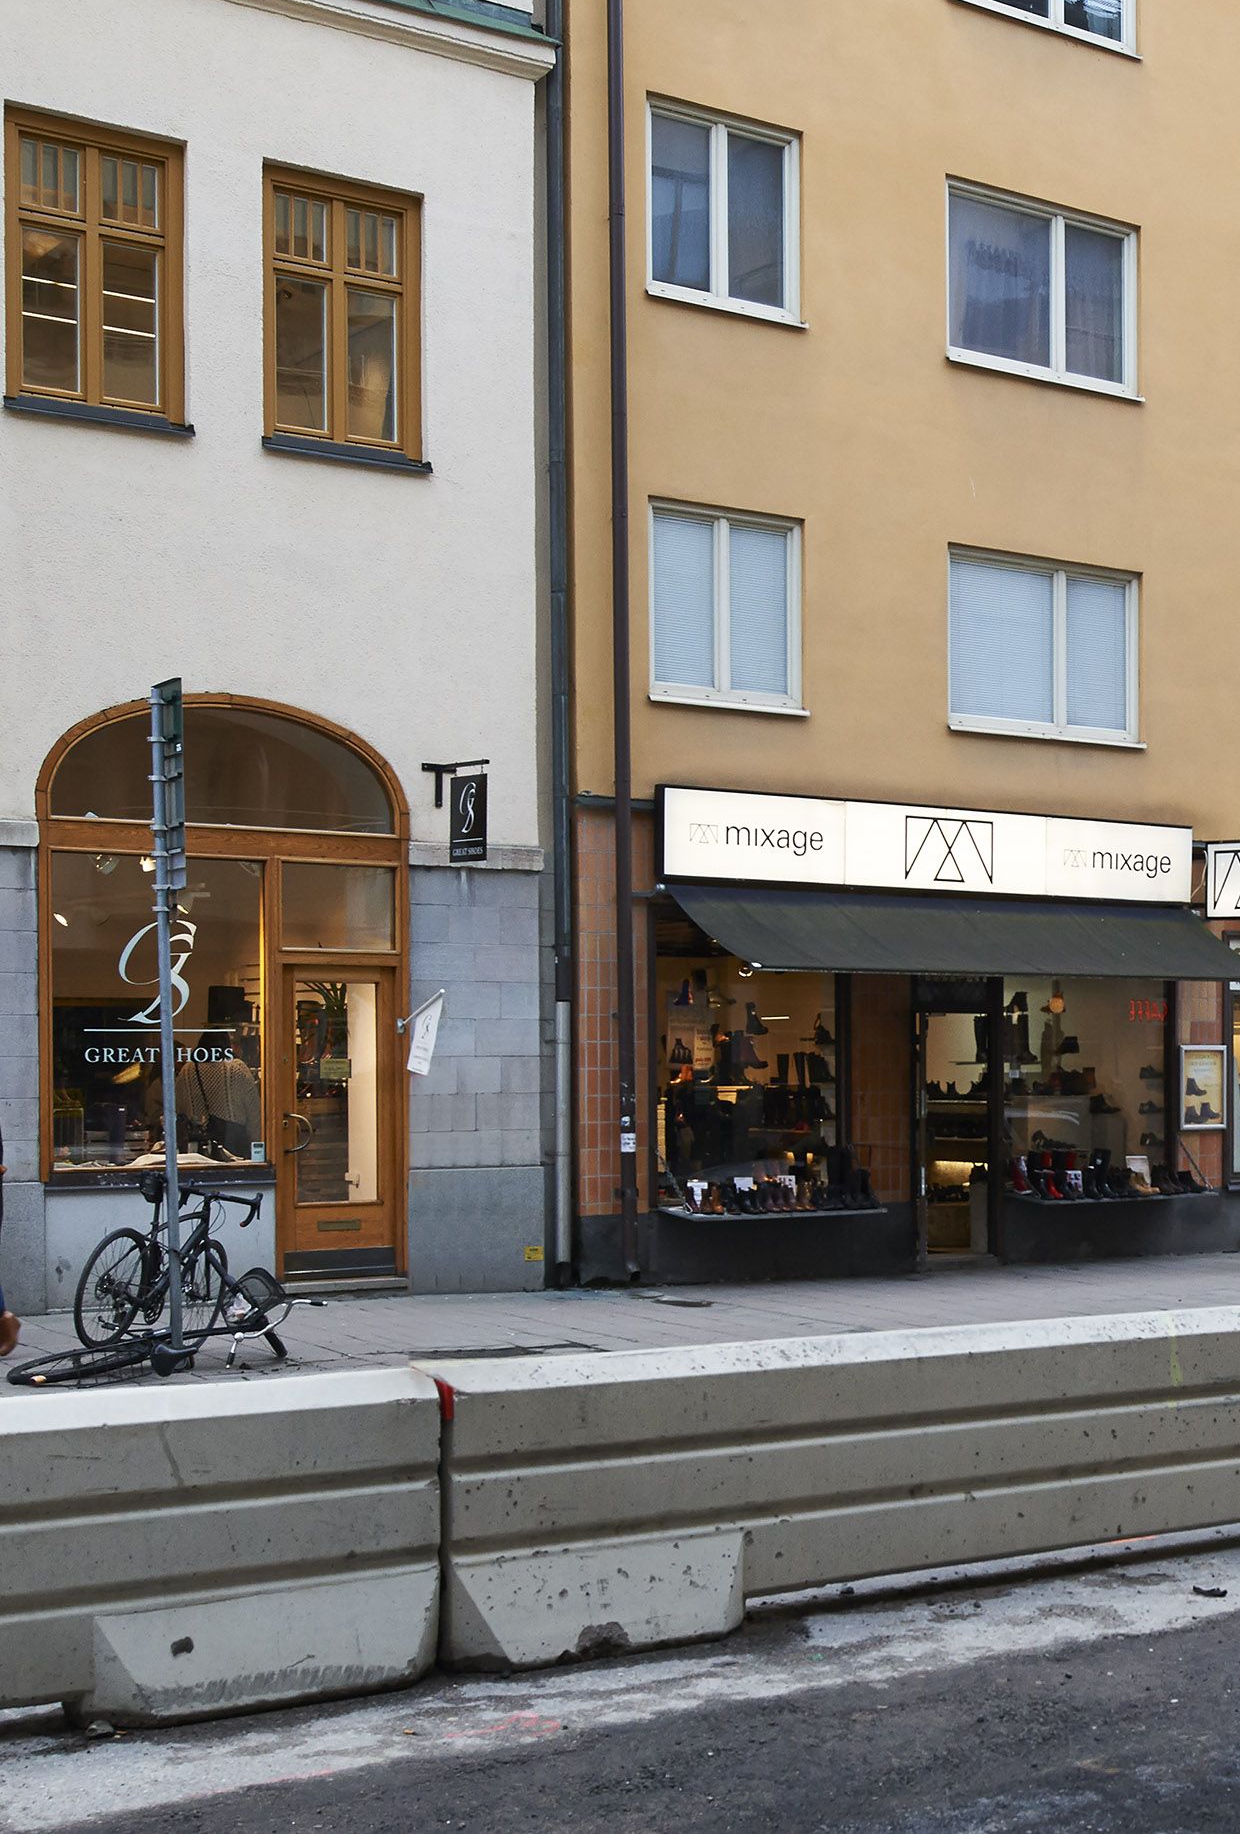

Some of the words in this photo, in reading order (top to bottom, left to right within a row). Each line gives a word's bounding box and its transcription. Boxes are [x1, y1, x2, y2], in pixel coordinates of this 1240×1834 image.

[726, 825, 823, 856] mixage
[1092, 851, 1171, 878] mixage
[84, 1047, 160, 1063] GREAT
[177, 1047, 234, 1063] HOES
